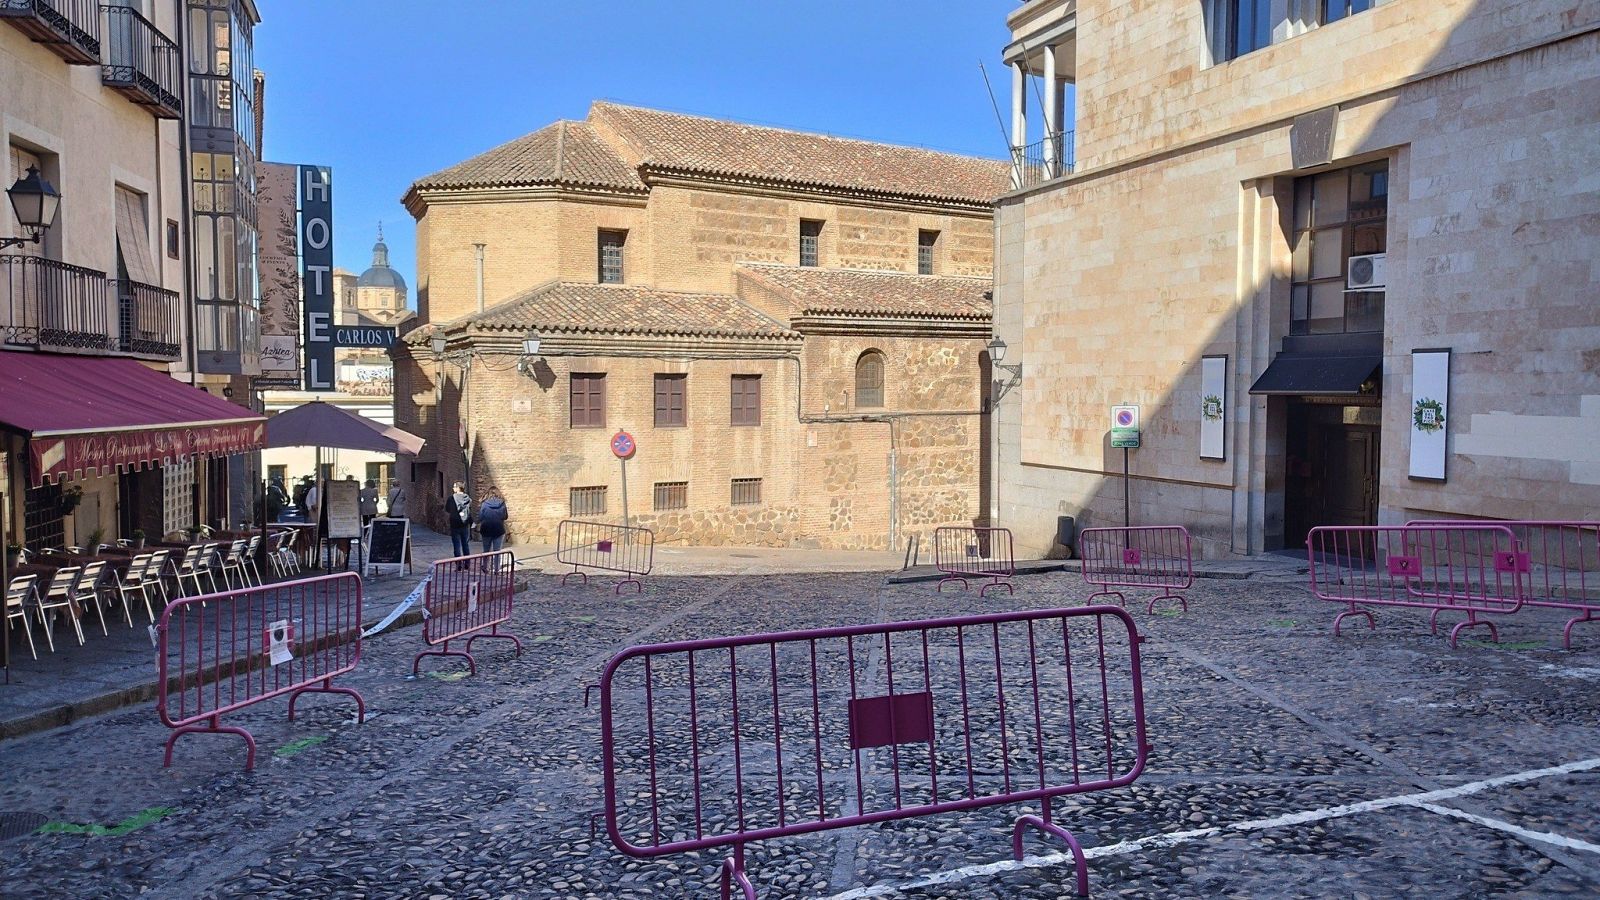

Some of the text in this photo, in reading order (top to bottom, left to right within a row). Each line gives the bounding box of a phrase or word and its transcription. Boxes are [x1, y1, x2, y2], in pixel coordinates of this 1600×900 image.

[306, 170, 331, 389] HOTEL
[336, 328, 394, 345] CARLOS V
